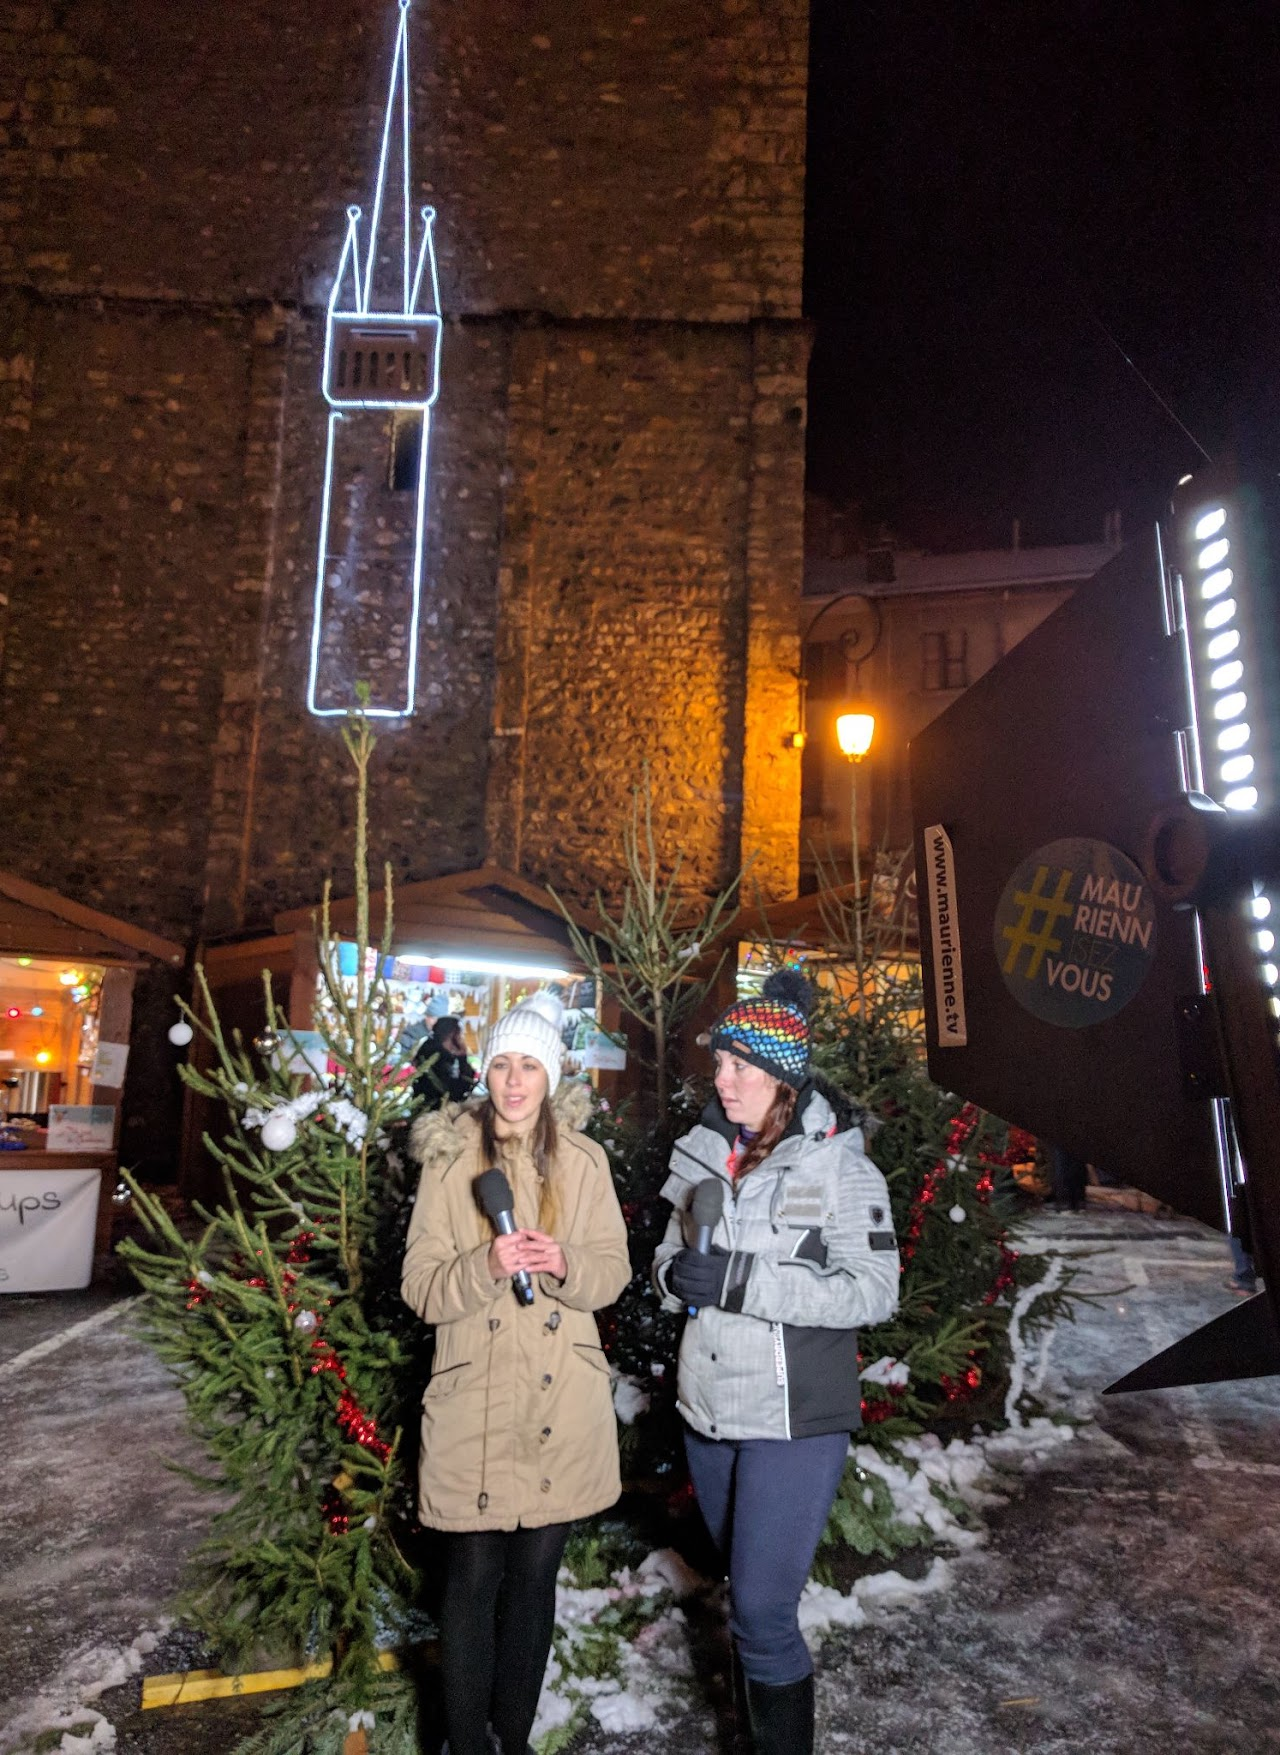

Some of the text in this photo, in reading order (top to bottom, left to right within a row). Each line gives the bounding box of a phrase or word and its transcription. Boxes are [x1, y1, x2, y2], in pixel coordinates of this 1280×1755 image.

[1080, 874, 1142, 911] MAU
[933, 836, 958, 1034] www.maurienne.tv
[1074, 905, 1152, 948] RIENN
[1067, 934, 1120, 971] ISEZ
[1046, 957, 1114, 1002] VOUS
